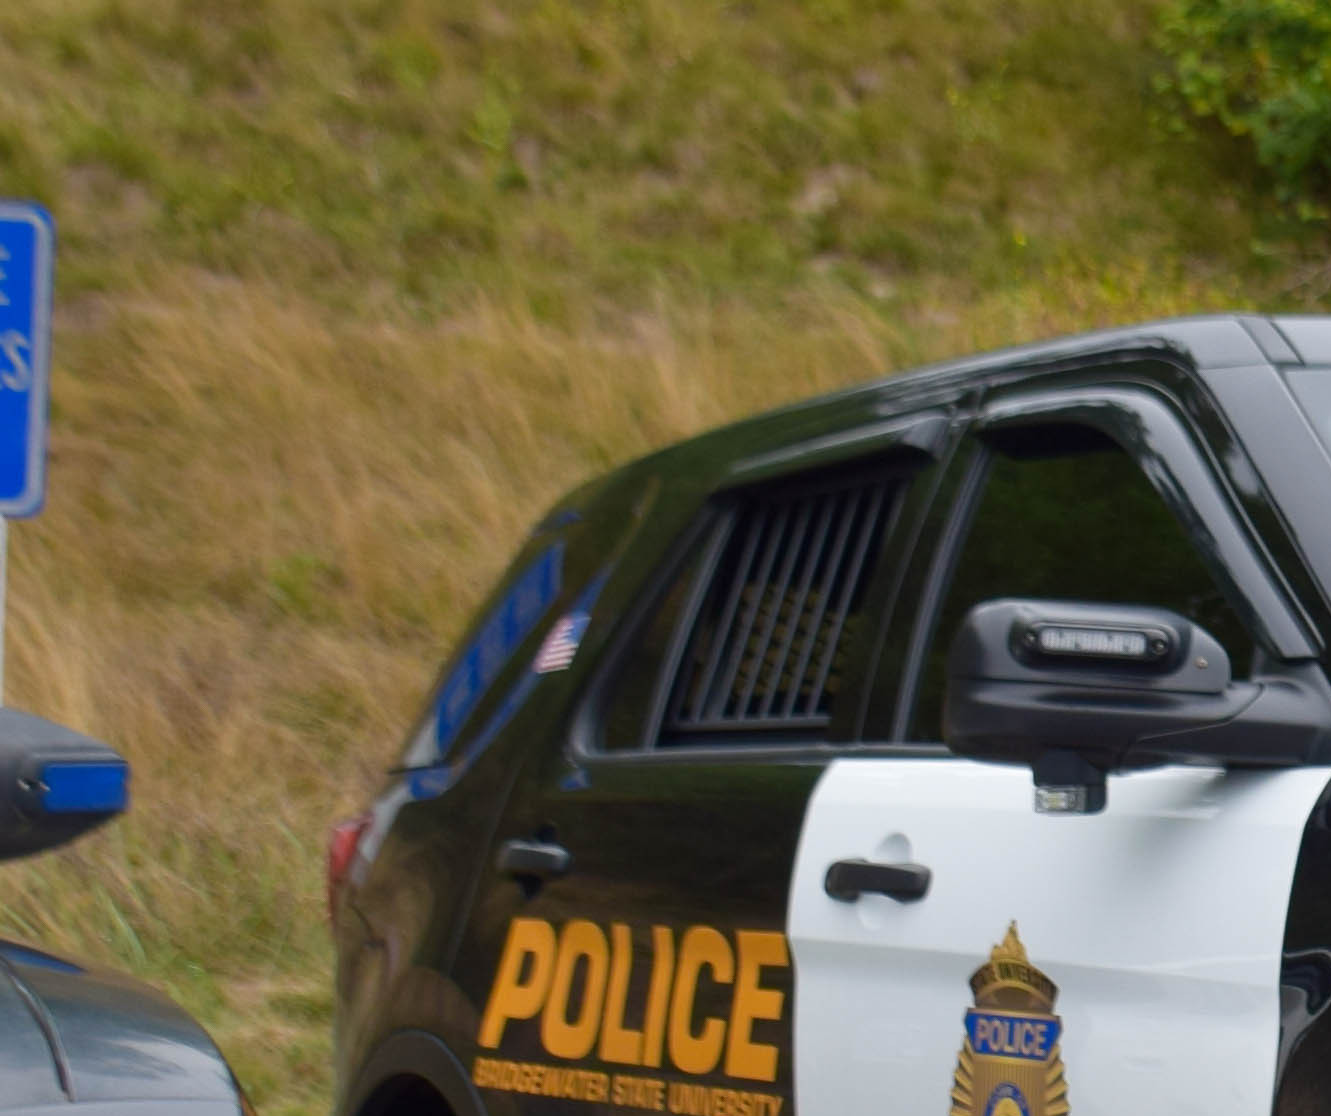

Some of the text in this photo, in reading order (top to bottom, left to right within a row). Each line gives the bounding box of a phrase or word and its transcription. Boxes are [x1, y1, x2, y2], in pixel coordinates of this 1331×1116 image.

[477, 917, 790, 1083] POLICE
[974, 1018, 1050, 1057] POLICE
[472, 1056, 609, 1103] BRIDGEWATER
[612, 1074, 666, 1112] STATE
